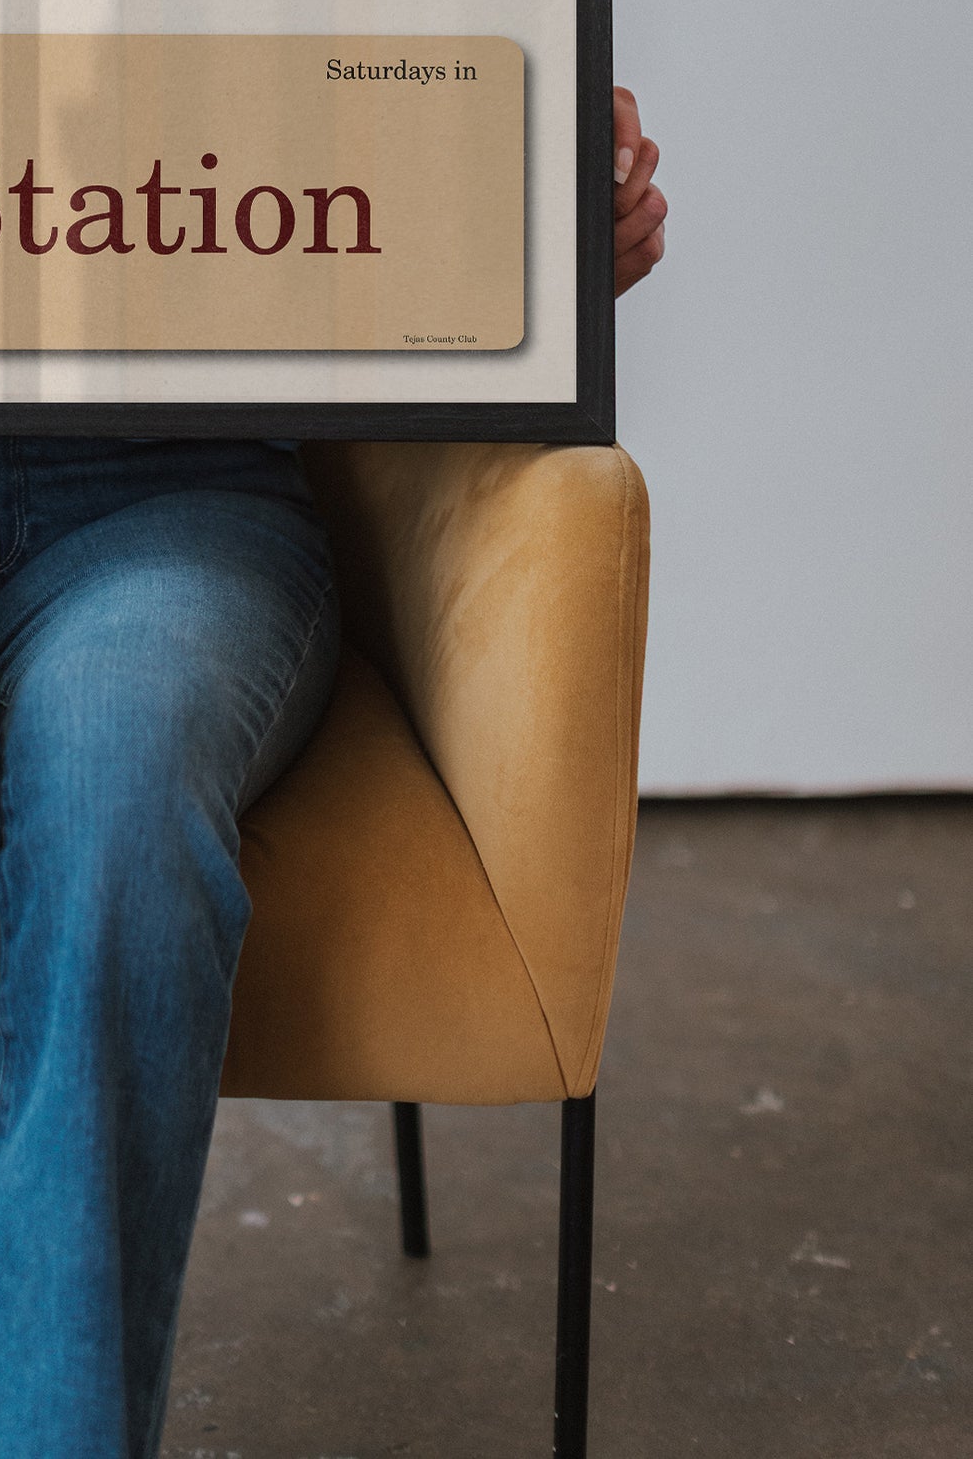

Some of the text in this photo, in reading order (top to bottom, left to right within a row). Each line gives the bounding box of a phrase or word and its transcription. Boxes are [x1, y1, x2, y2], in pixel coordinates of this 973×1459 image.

[326, 59, 478, 85] Saturdays in
[403, 335, 477, 345] Tejas County Club
